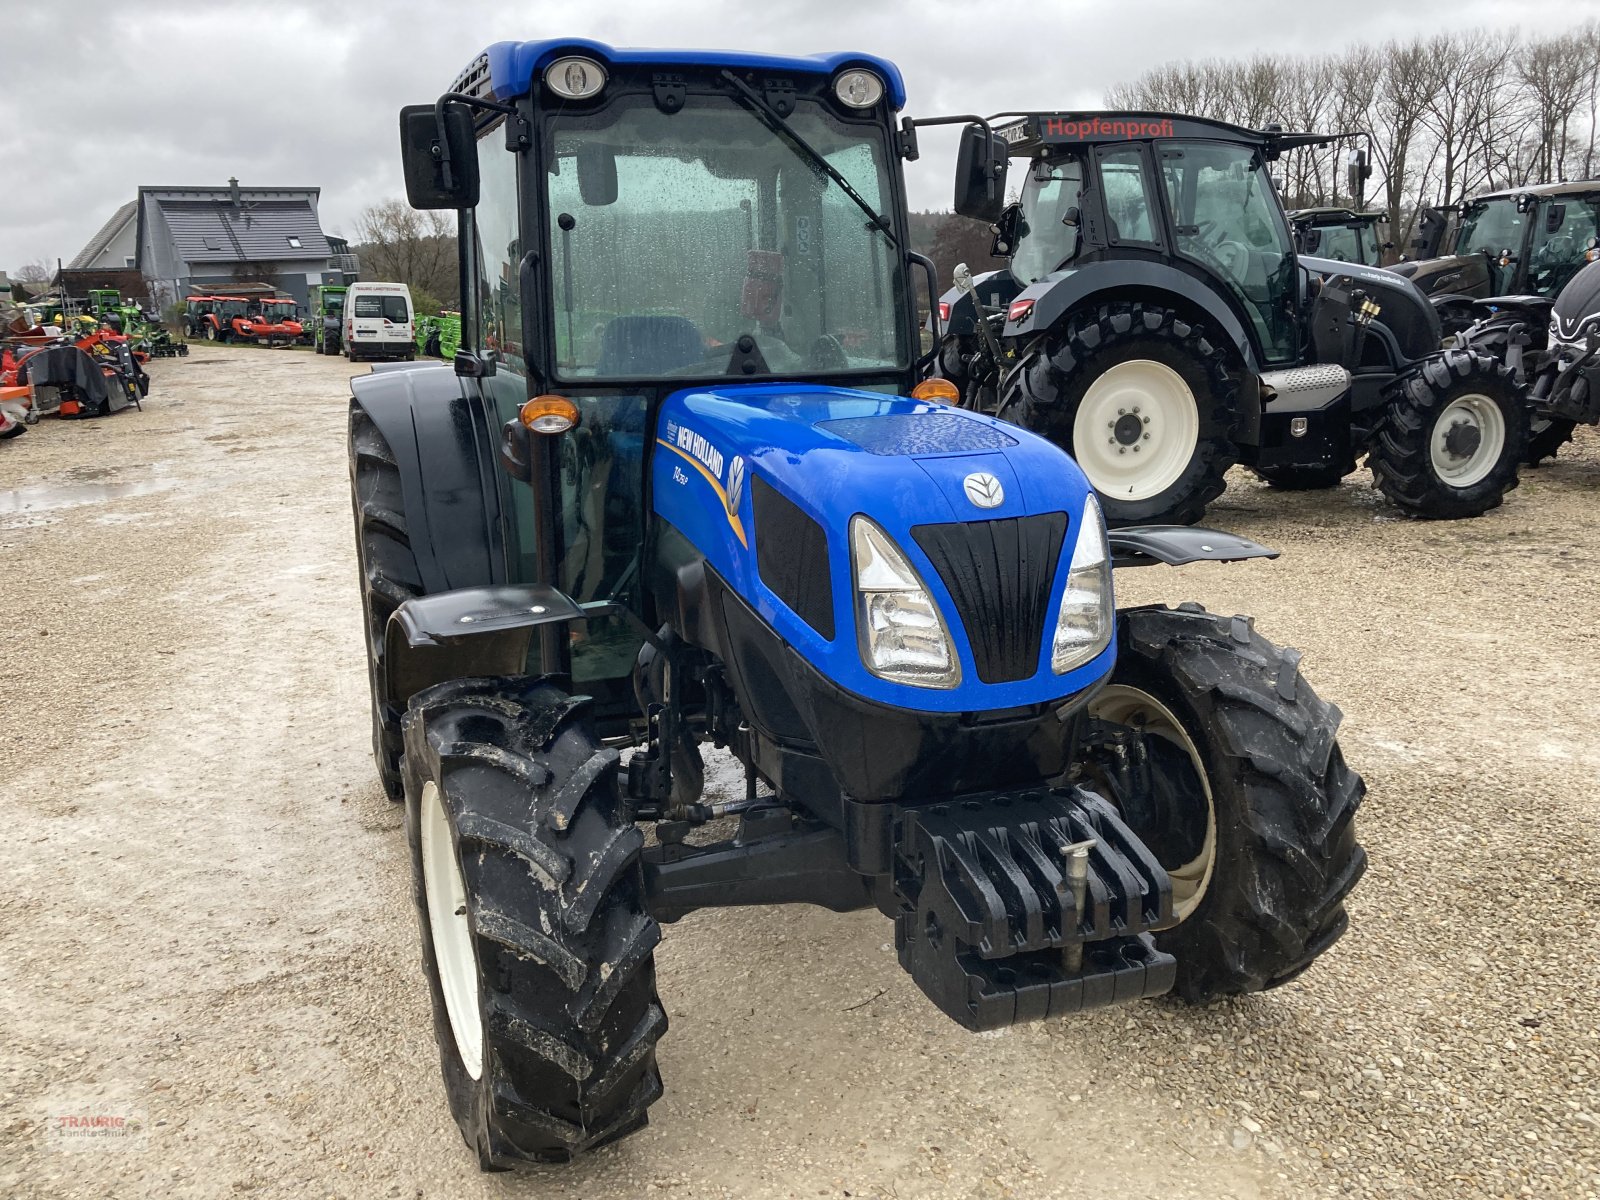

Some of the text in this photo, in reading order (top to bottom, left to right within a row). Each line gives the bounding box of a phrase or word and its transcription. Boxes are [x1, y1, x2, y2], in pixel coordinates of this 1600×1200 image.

[1047, 118, 1173, 139] Hopfenprofi
[677, 426, 694, 452] NEW
[692, 433, 723, 479] HOLLAND
